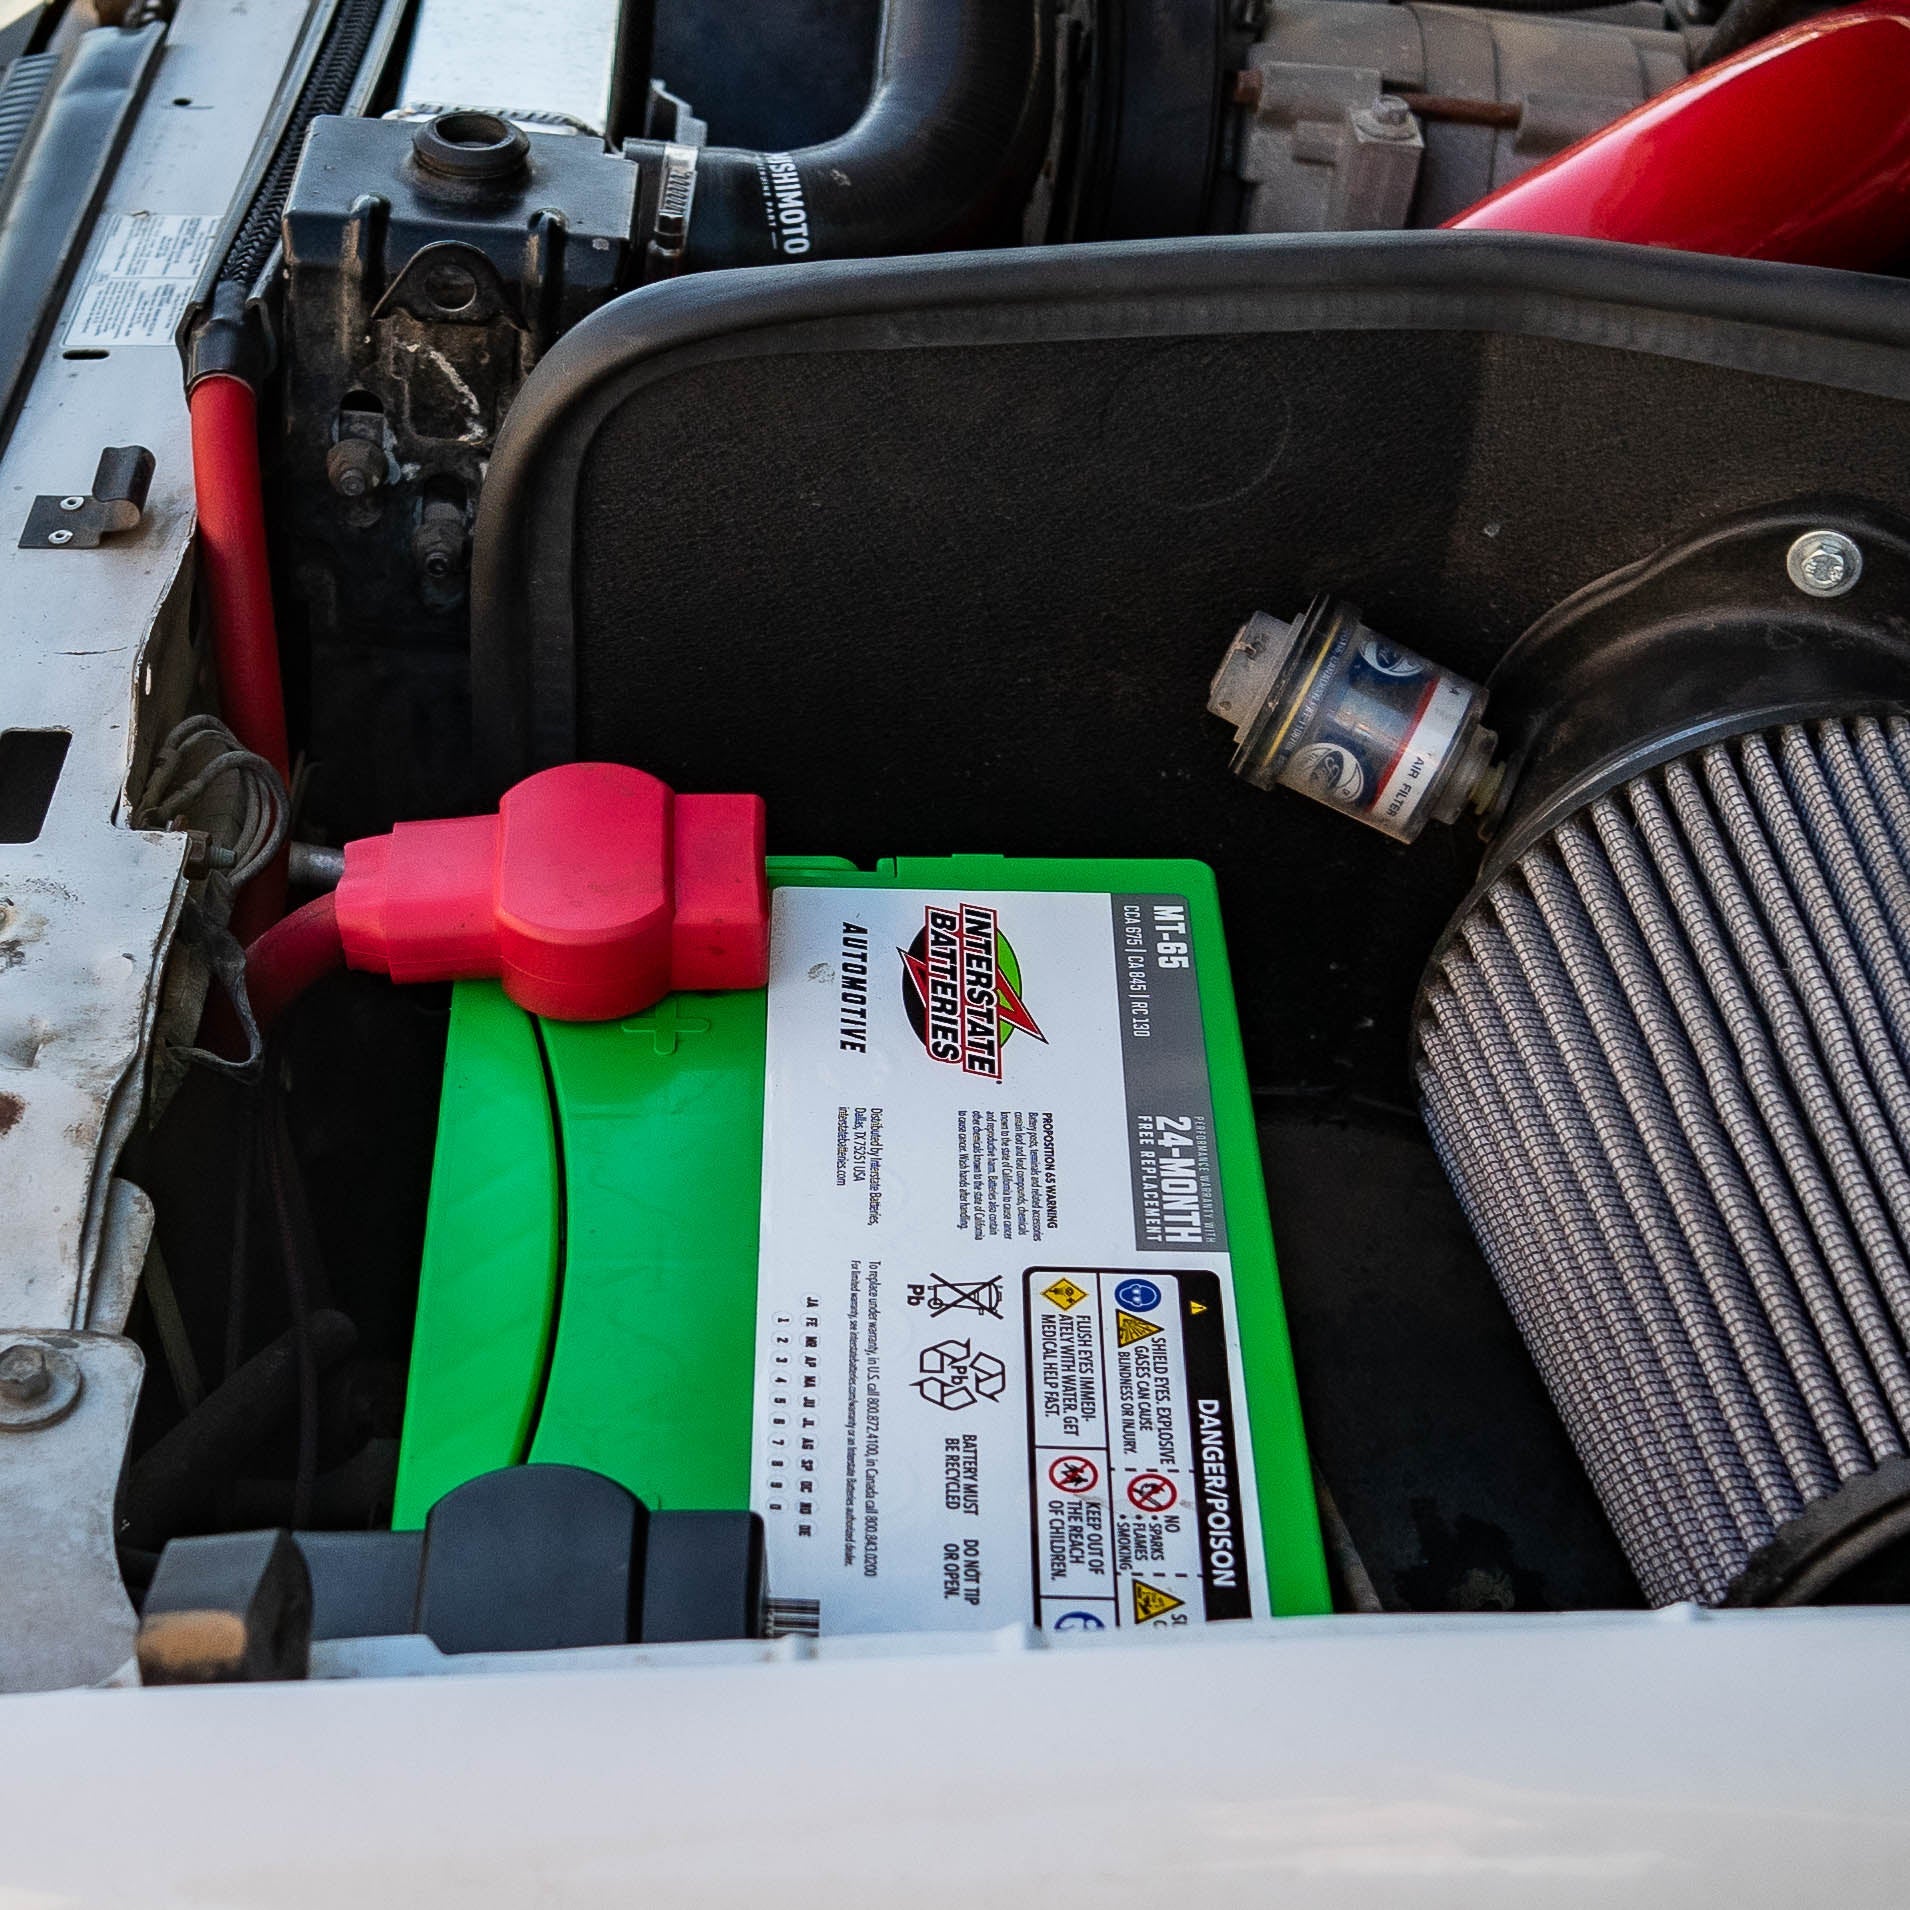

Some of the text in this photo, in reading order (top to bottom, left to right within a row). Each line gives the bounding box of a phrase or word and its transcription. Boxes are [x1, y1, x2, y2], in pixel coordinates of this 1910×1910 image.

[1386, 757, 1424, 817] AIR FILTER
[1152, 905, 1189, 969] MT-65
[928, 910, 961, 1060] BATTERIES
[1122, 905, 1150, 1036] CCA 675 CA 845 RC 130
[839, 921, 867, 1053] AUTOMOTIVE
[962, 908, 997, 1073] INTERSTATE
[957, 1117, 965, 1132] cause
[971, 1110, 982, 1125] other
[999, 1111, 1011, 1129] known
[836, 1106, 849, 1186] interstatebatteries.com
[852, 1107, 866, 1181] Dallas, TX 75251 USA
[958, 1133, 966, 1152] cancer.
[972, 1125, 984, 1153] chemicals
[1000, 1137, 1011, 1146] the
[1001, 1147, 1011, 1160] state
[866, 1107, 883, 1226] Distributed by Interstate Batteries,
[958, 1153, 969, 1169] Wash
[972, 1154, 984, 1172] known
[984, 1111, 999, 1235] and reproductive harm. Batteries also contain
[1013, 1111, 1029, 1235] contain lead and lead compounds, chemicals
[1041, 1112, 1057, 1228] PROPOSITION 65 WARNING
[958, 1170, 969, 1187] hands
[973, 1180, 984, 1189] the
[1001, 1168, 1013, 1195] California
[1025, 1112, 1043, 1241] Battery posts, terminals and related accessories
[1136, 1115, 1162, 1241] FREE REPLACEMENT
[1155, 1115, 1203, 1242] 24-MONTH
[1193, 1116, 1216, 1242] PERFORMANCE WARRANTY WITH
[959, 1188, 970, 1201] after
[973, 1191, 983, 1204] state
[956, 1202, 970, 1229] handling.
[973, 1212, 985, 1240] California
[1002, 1203, 1011, 1219] cause
[1003, 1220, 1012, 1239] cancer
[868, 1260, 881, 1269] To
[865, 1270, 881, 1296] replace
[907, 1284, 924, 1306] Pb
[806, 1296, 817, 1307] JA
[867, 1298, 880, 1320] under
[805, 1317, 817, 1326] FE
[864, 1322, 879, 1355] warranty,
[804, 1355, 816, 1367] AP
[866, 1366, 879, 1381] U.S.
[950, 1365, 968, 1385] Pb
[1039, 1314, 1060, 1417] MEDICAL HELP FAST.
[1057, 1313, 1079, 1435] ATELY WITH WATER. GET
[1074, 1315, 1097, 1421] FLUSH EYES IMMEDI-
[803, 1375, 815, 1387] MA
[866, 1383, 879, 1396] call
[1133, 1345, 1153, 1430] GASES CAN CAUSE
[803, 1396, 814, 1407] JU
[1116, 1351, 1137, 1454] BLINDNESS OR INJURY.
[1150, 1337, 1175, 1464] SHIELD EYES. EXPLOSIVE
[802, 1417, 814, 1428] JL
[864, 1397, 879, 1456] 800.872.4100,
[801, 1437, 814, 1449] AG
[800, 1459, 813, 1471] SP
[866, 1459, 877, 1467] in
[944, 1438, 960, 1509] BE RECYCLED
[961, 1434, 979, 1515] BATTERY MUST
[865, 1468, 878, 1498] Canada
[1196, 1399, 1237, 1587] DANGER/POISON
[865, 1499, 878, 1513] call
[1066, 1500, 1085, 1563] THE REACH
[1084, 1501, 1104, 1574] KEEP OUT OF
[1163, 1515, 1180, 1532] NO
[863, 1516, 877, 1576] 800.843.0200
[1046, 1500, 1067, 1580] OF CHILDREN.
[1116, 1522, 1132, 1570] SMOKING
[1132, 1522, 1147, 1560] FLAMES
[1148, 1522, 1163, 1560] SPARKS
[942, 1543, 960, 1598] OR OPEN.
[962, 1539, 980, 1605] DO NOT TIP
